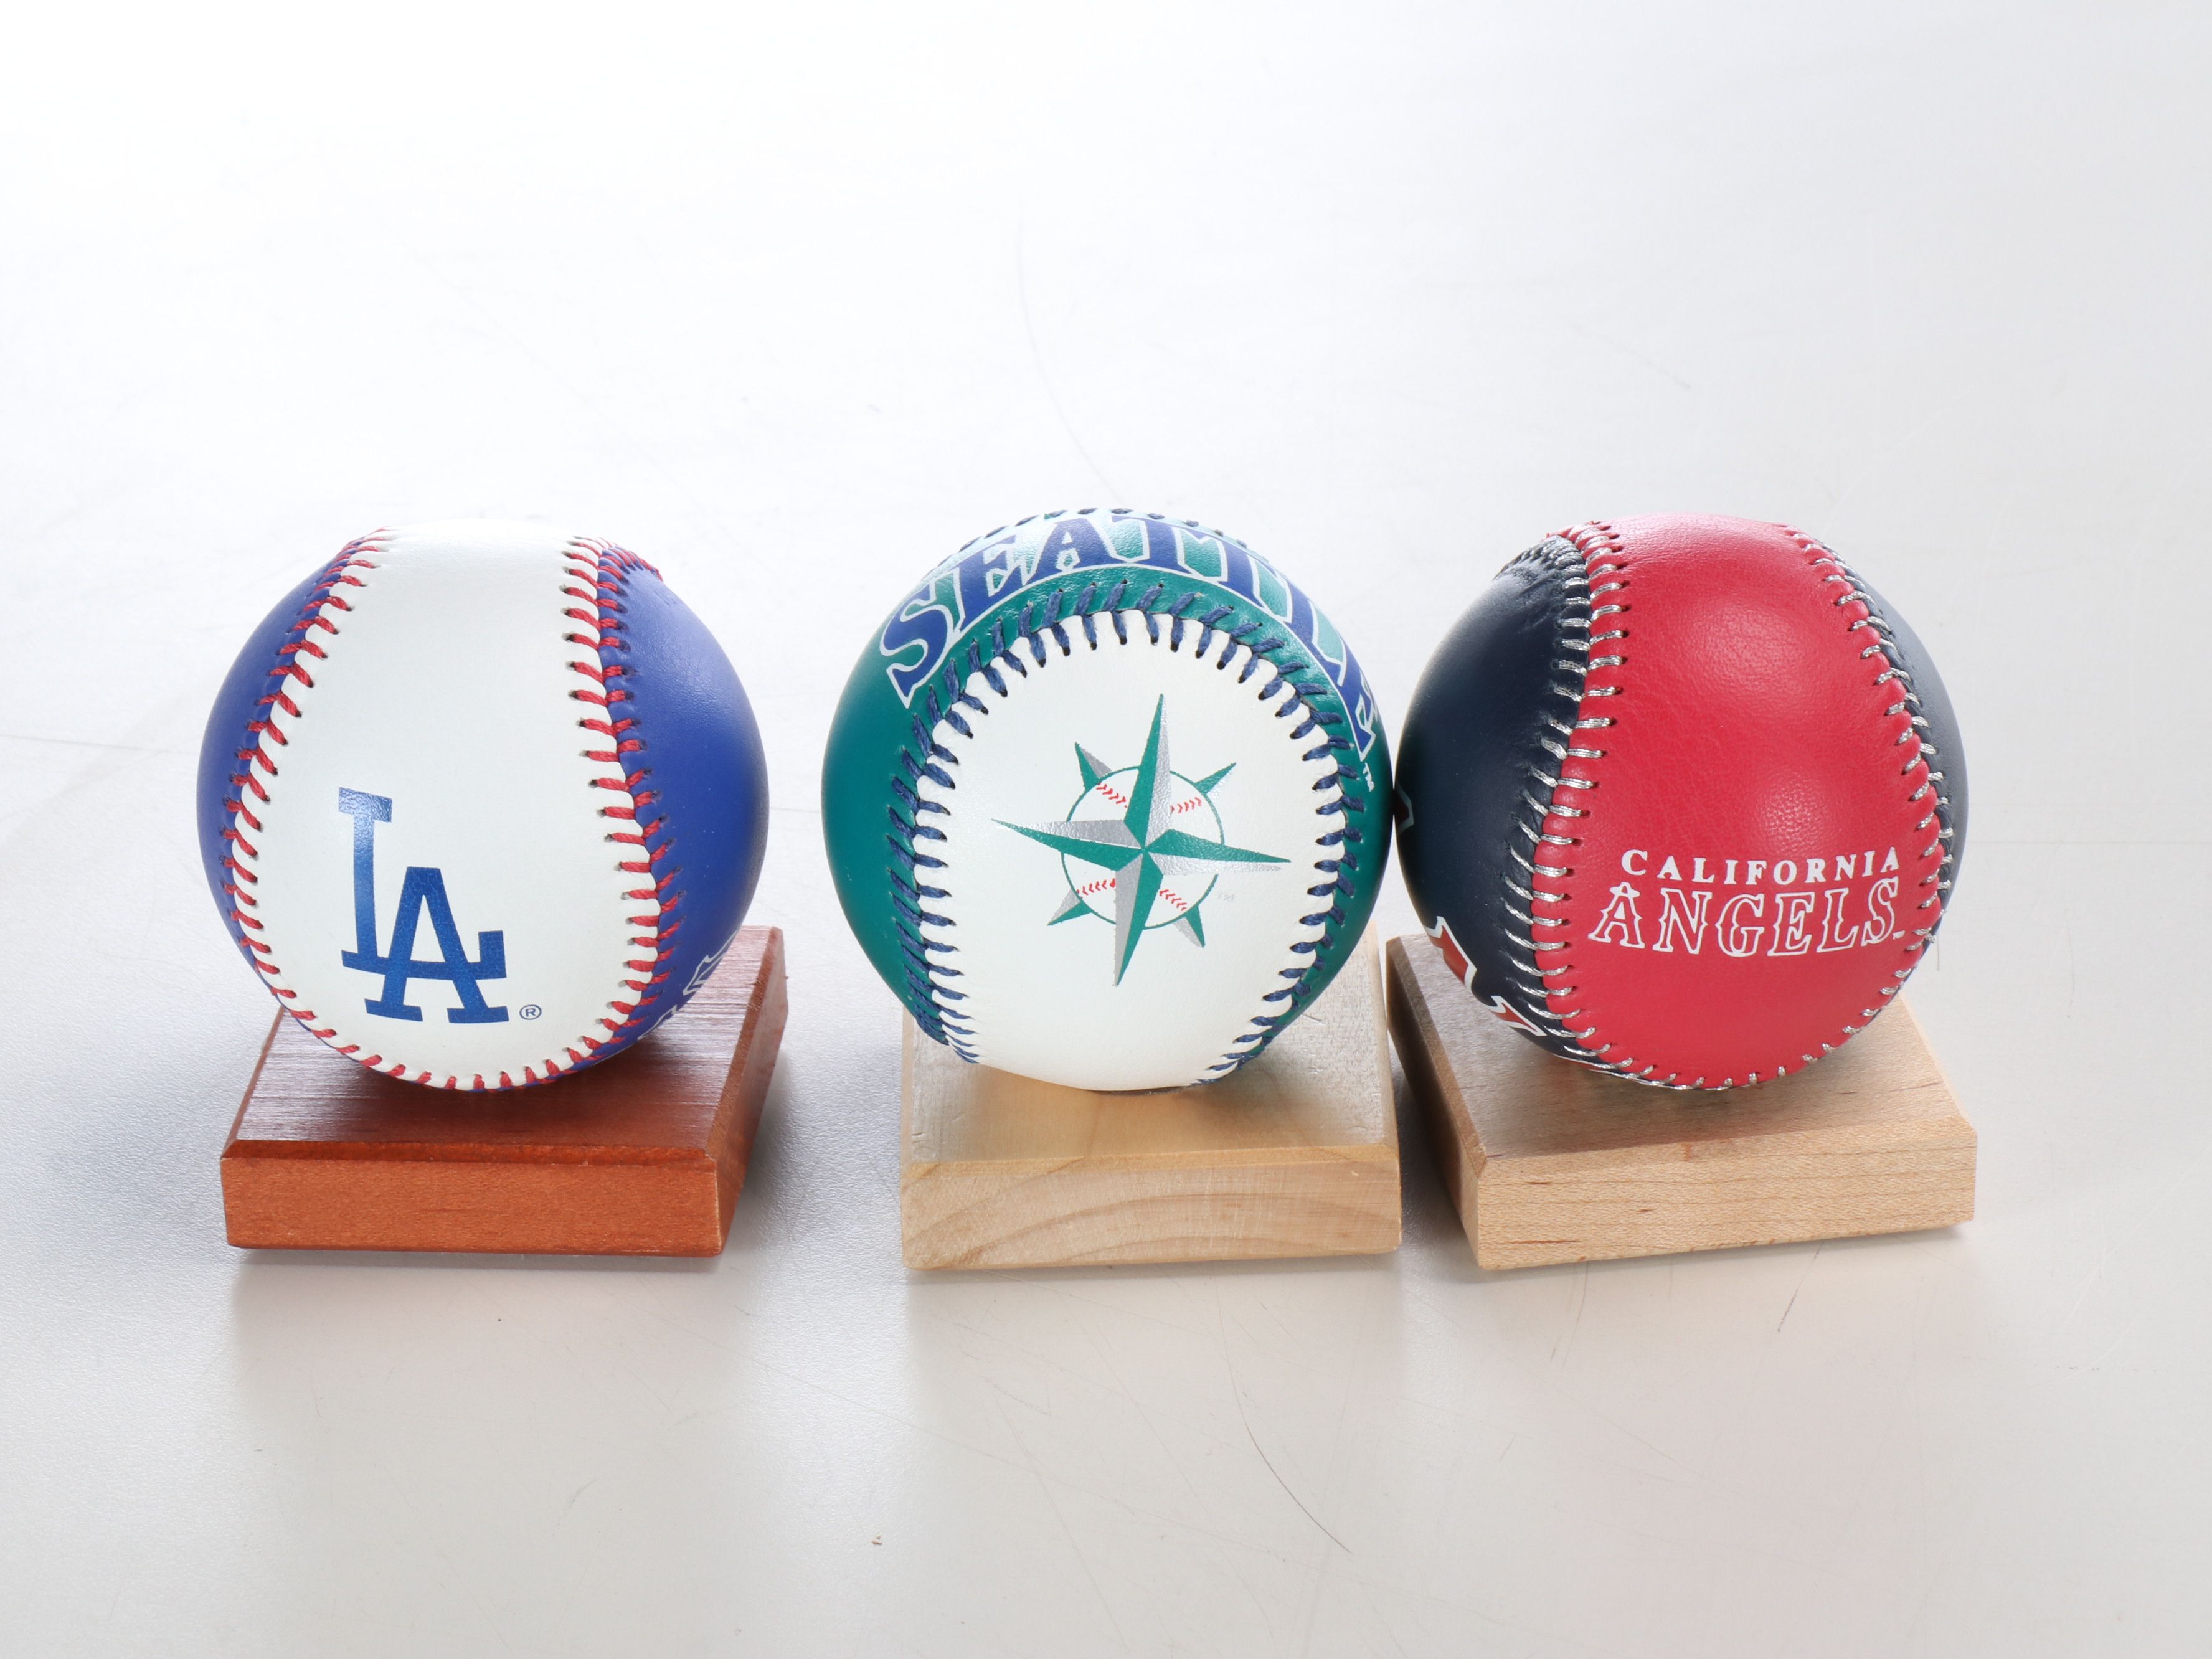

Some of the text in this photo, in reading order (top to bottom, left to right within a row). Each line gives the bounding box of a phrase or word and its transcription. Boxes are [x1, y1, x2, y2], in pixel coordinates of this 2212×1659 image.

[879, 516, 1377, 762] SEATTLE
[338, 787, 509, 1023] LA
[1587, 876, 1899, 958] ANGELS
[1621, 846, 1900, 885] CALIFORNIA
